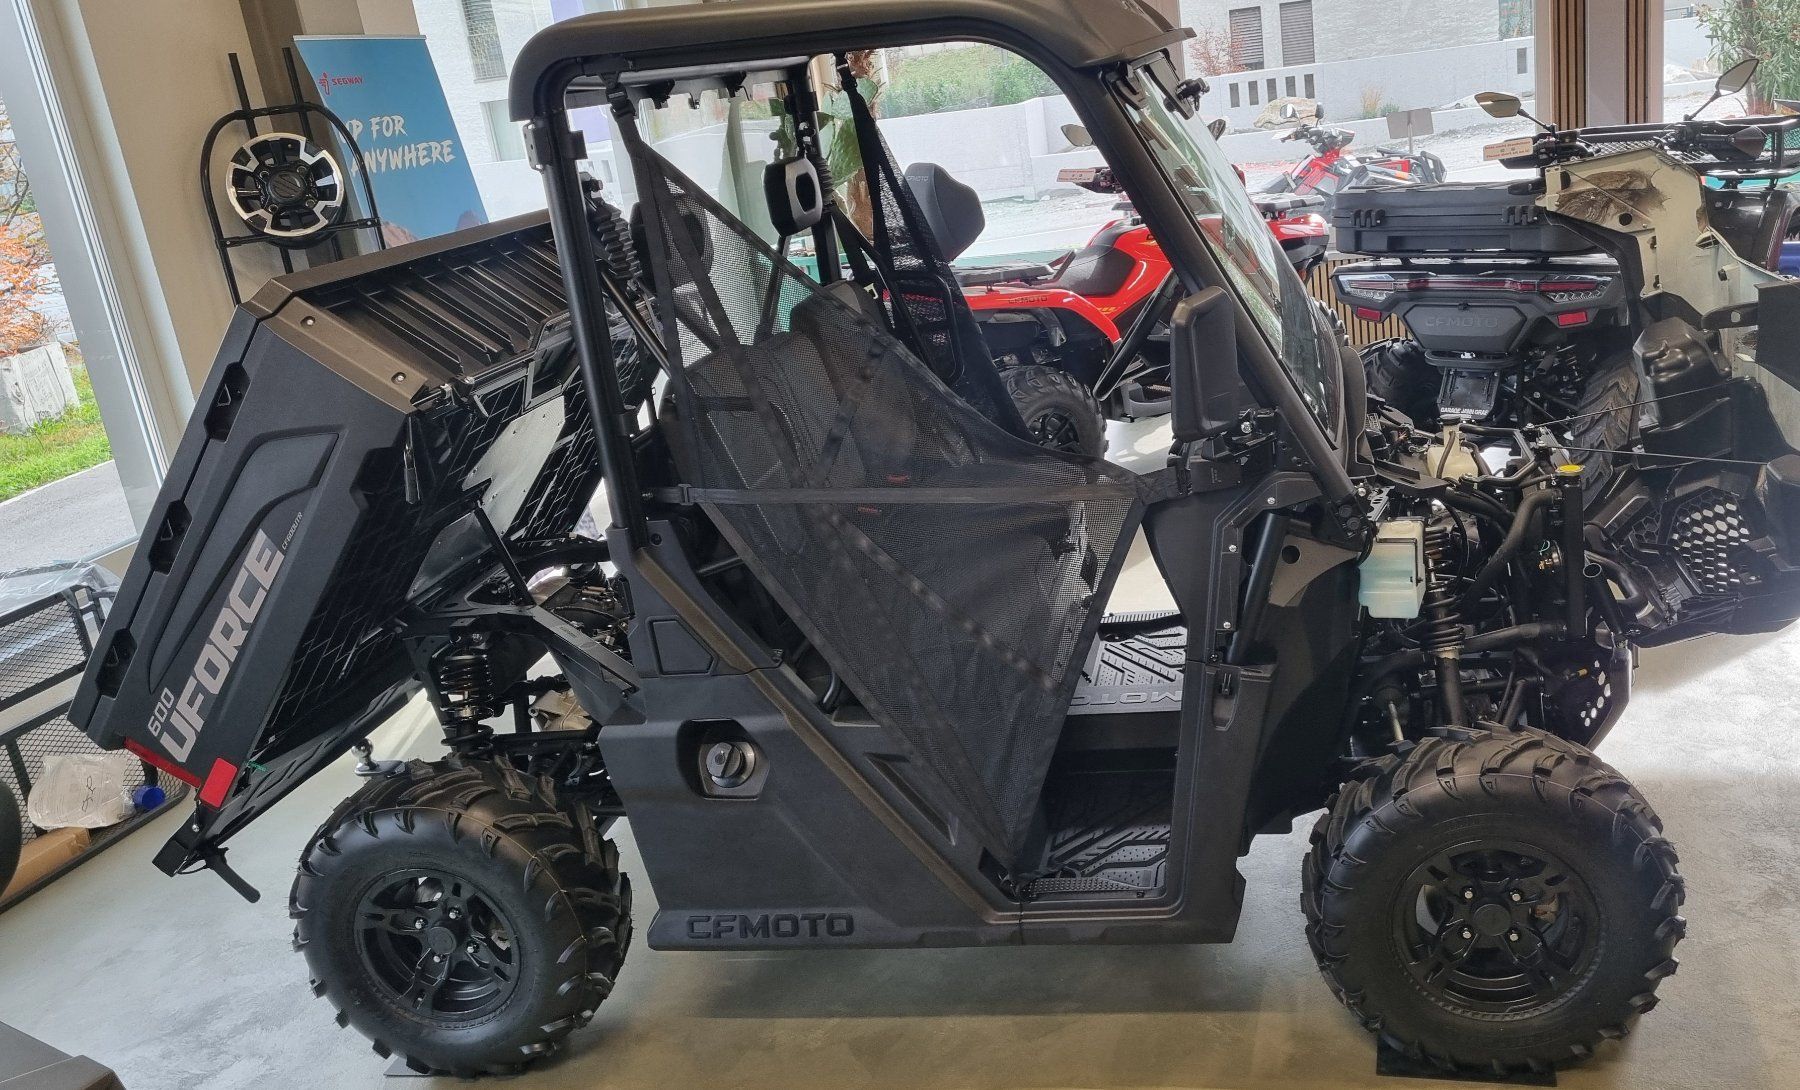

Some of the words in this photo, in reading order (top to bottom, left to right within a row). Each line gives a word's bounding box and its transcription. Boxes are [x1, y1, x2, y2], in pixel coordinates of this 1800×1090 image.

[331, 76, 363, 86] SEGWAY
[369, 115, 408, 142] FOR
[1425, 317, 1499, 328] CFMOTO
[160, 528, 285, 763] UFORCE
[147, 687, 175, 737] 600
[686, 913, 855, 939] CFMOTO
